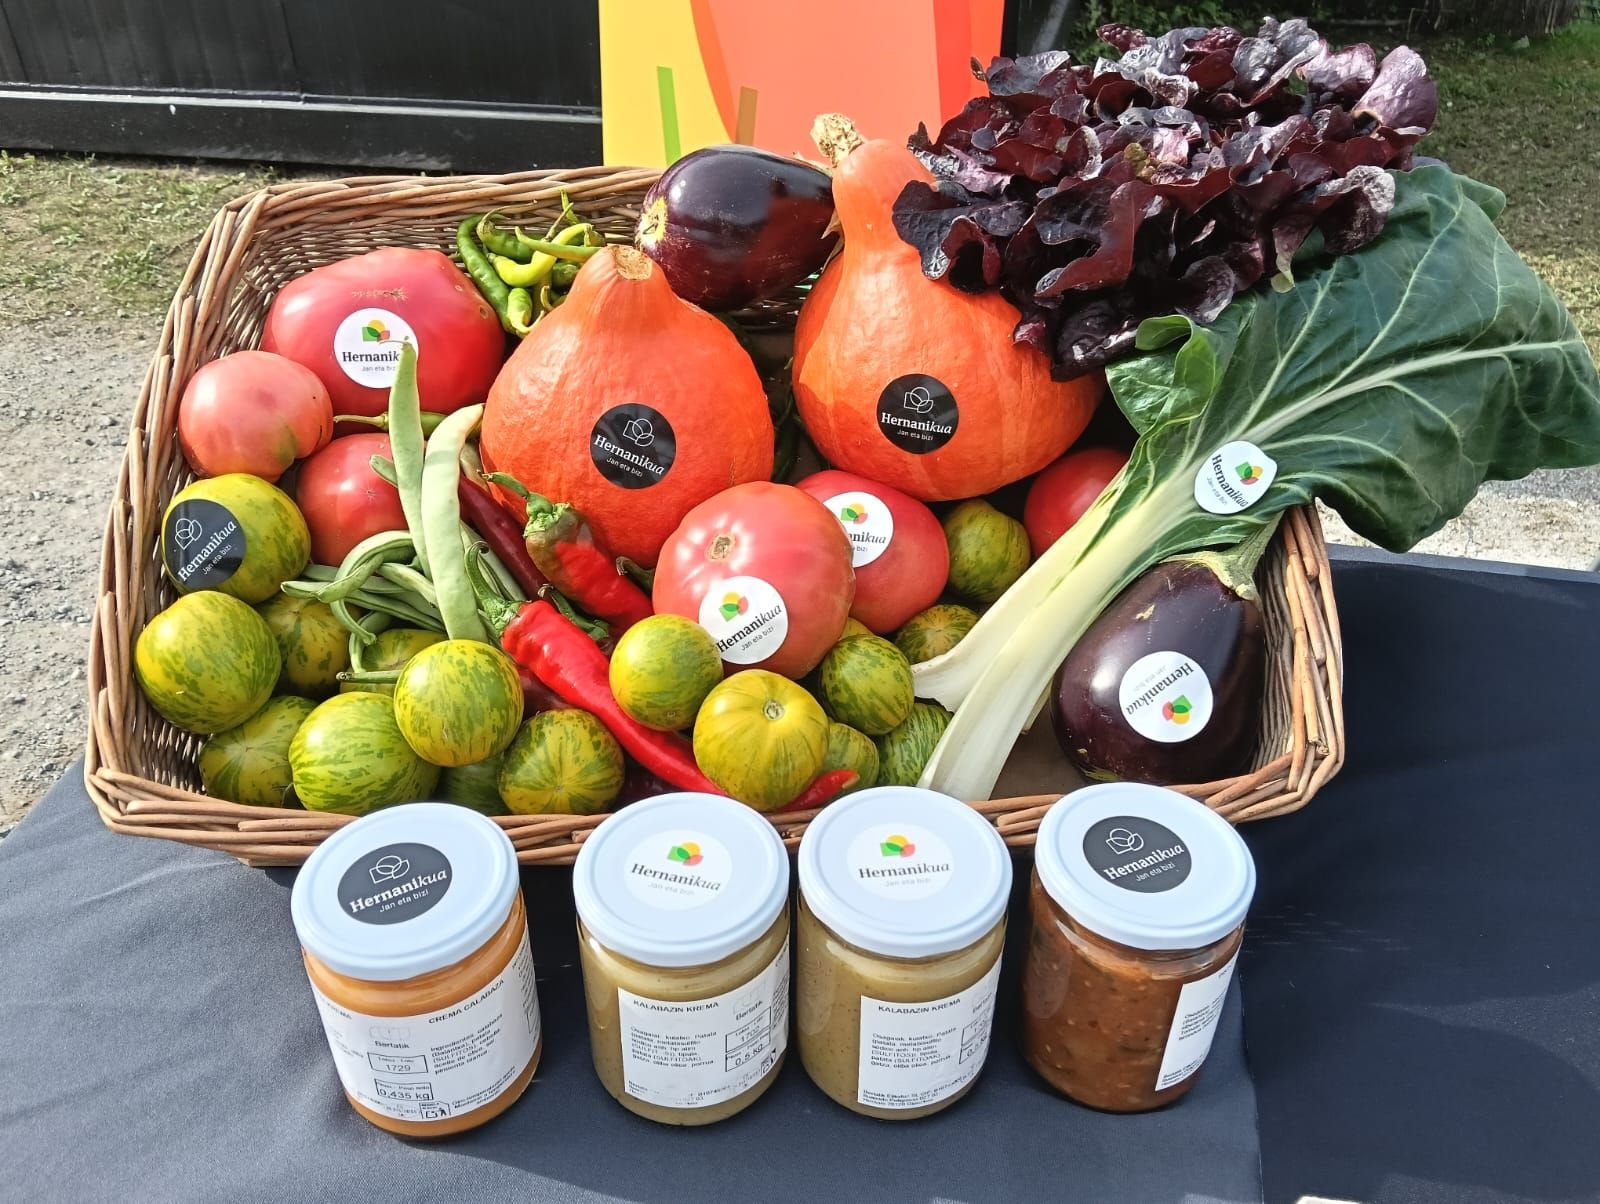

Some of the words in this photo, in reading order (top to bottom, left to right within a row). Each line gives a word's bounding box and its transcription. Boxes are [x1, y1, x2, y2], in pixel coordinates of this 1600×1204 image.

[342, 351, 400, 363] Hernanik
[881, 412, 953, 434] Hernanikua
[593, 434, 665, 475] Hernanikua
[606, 457, 619, 467] Jan
[620, 462, 631, 472] eta
[1212, 454, 1249, 507] Hernanikua
[177, 520, 237, 581] Hernanikua
[202, 562, 215, 575] Jan
[212, 553, 223, 565] eta
[220, 544, 232, 556] bizi
[716, 604, 782, 653] Hernanikua
[741, 641, 753, 651] Jan
[752, 634, 763, 643] eta
[762, 625, 774, 636] bizi
[1126, 662, 1194, 715] Hernanikua
[858, 862, 950, 879] Hernanikua
[1103, 844, 1185, 880] Hernanikua
[1136, 872, 1149, 882] Jan
[1150, 868, 1162, 876] eta
[1160, 861, 1176, 872] bizi
[632, 863, 721, 891] Hernanikua
[349, 869, 447, 913] Hernanikua
[379, 901, 396, 913] Jan
[397, 896, 412, 906] eta
[413, 889, 429, 900] bizi
[428, 1009, 462, 1024] CREMA
[464, 979, 504, 1011] CALABAZA
[633, 1000, 684, 1013] KALABAZIN
[686, 1001, 719, 1012] KREMA
[878, 1005, 930, 1014] KALABAZIN
[931, 998, 961, 1011] KREMA
[385, 1064, 411, 1072] 1729
[415, 1092, 430, 1101] kg
